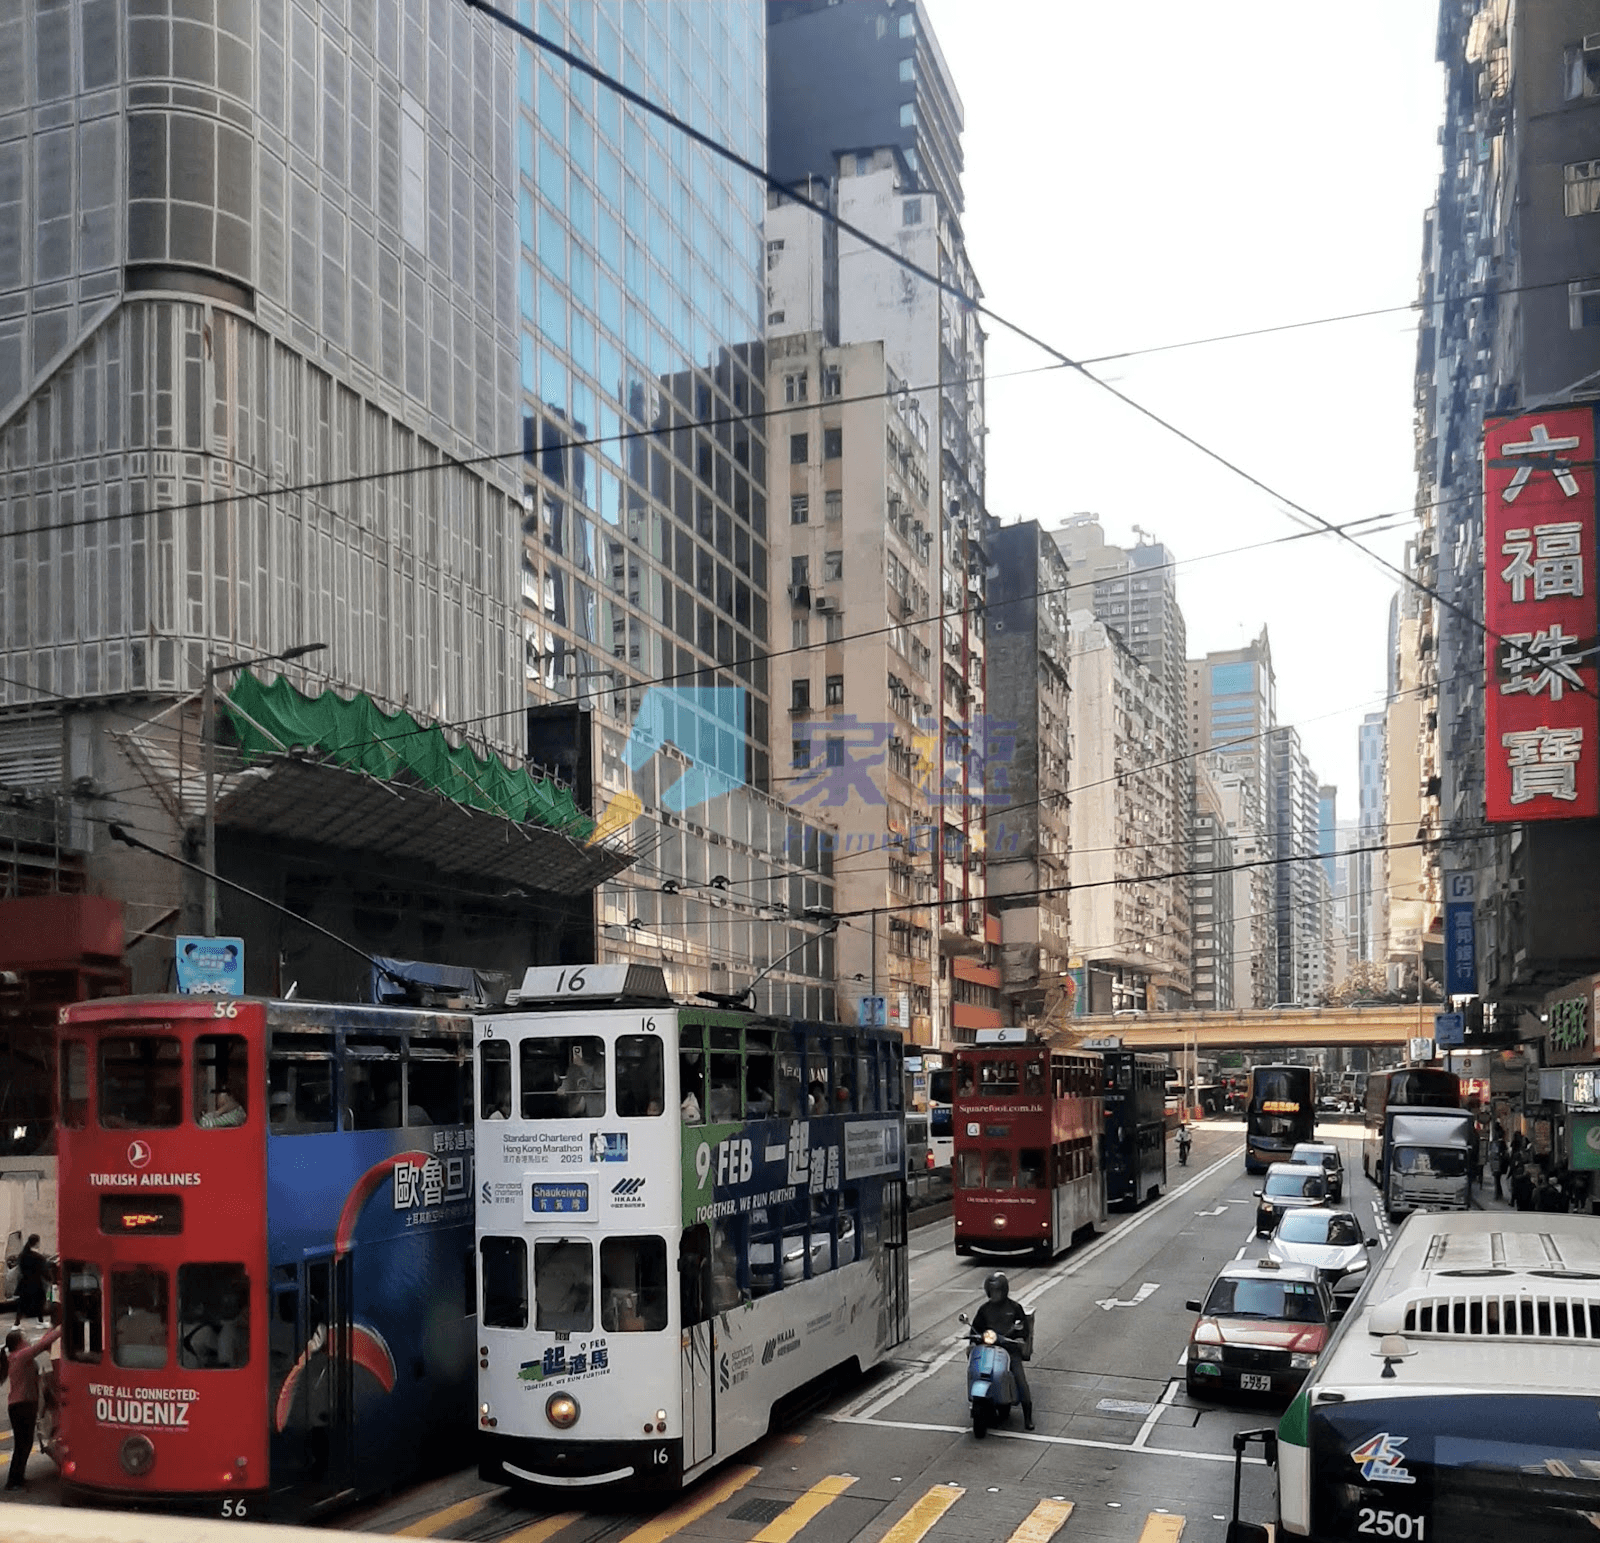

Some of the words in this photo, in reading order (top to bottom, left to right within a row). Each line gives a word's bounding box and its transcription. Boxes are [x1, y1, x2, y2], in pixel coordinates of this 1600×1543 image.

[1500, 423, 1584, 806] 六福珠寶
[555, 967, 587, 993] 16
[213, 1001, 239, 1019] 56
[483, 1023, 494, 1038] 16
[641, 1016, 656, 1032] 16
[997, 1029, 1007, 1041] 6
[503, 1133, 537, 1143] Standard
[538, 1132, 583, 1142] Chartered
[503, 1145, 522, 1155] Hong
[522, 1145, 543, 1155] Kong
[543, 1144, 583, 1153] Marathon
[560, 1155, 583, 1163] 2025
[695, 1141, 711, 1190] 9
[717, 1138, 753, 1187] FEB
[90, 1173, 138, 1186] TURKISH
[140, 1173, 202, 1186] AIRLINES
[533, 1187, 588, 1198] Shaukeiwan
[696, 1200, 737, 1223] TOGETHER,
[739, 1198, 751, 1212] WE
[752, 1192, 768, 1210] RUN
[768, 1186, 797, 1204] FURTHER
[580, 1342, 587, 1351] 9
[590, 1338, 607, 1349] FEB
[520, 1345, 609, 1376] 一起渣馬
[88, 1382, 115, 1397] WE'RE
[116, 1386, 133, 1399] ALL
[134, 1387, 201, 1401] CONNECTED:
[96, 1398, 190, 1426] OLUDENIZ
[653, 1447, 669, 1464] 16
[220, 1498, 248, 1518] 56
[1357, 1507, 1425, 1542] 2501
